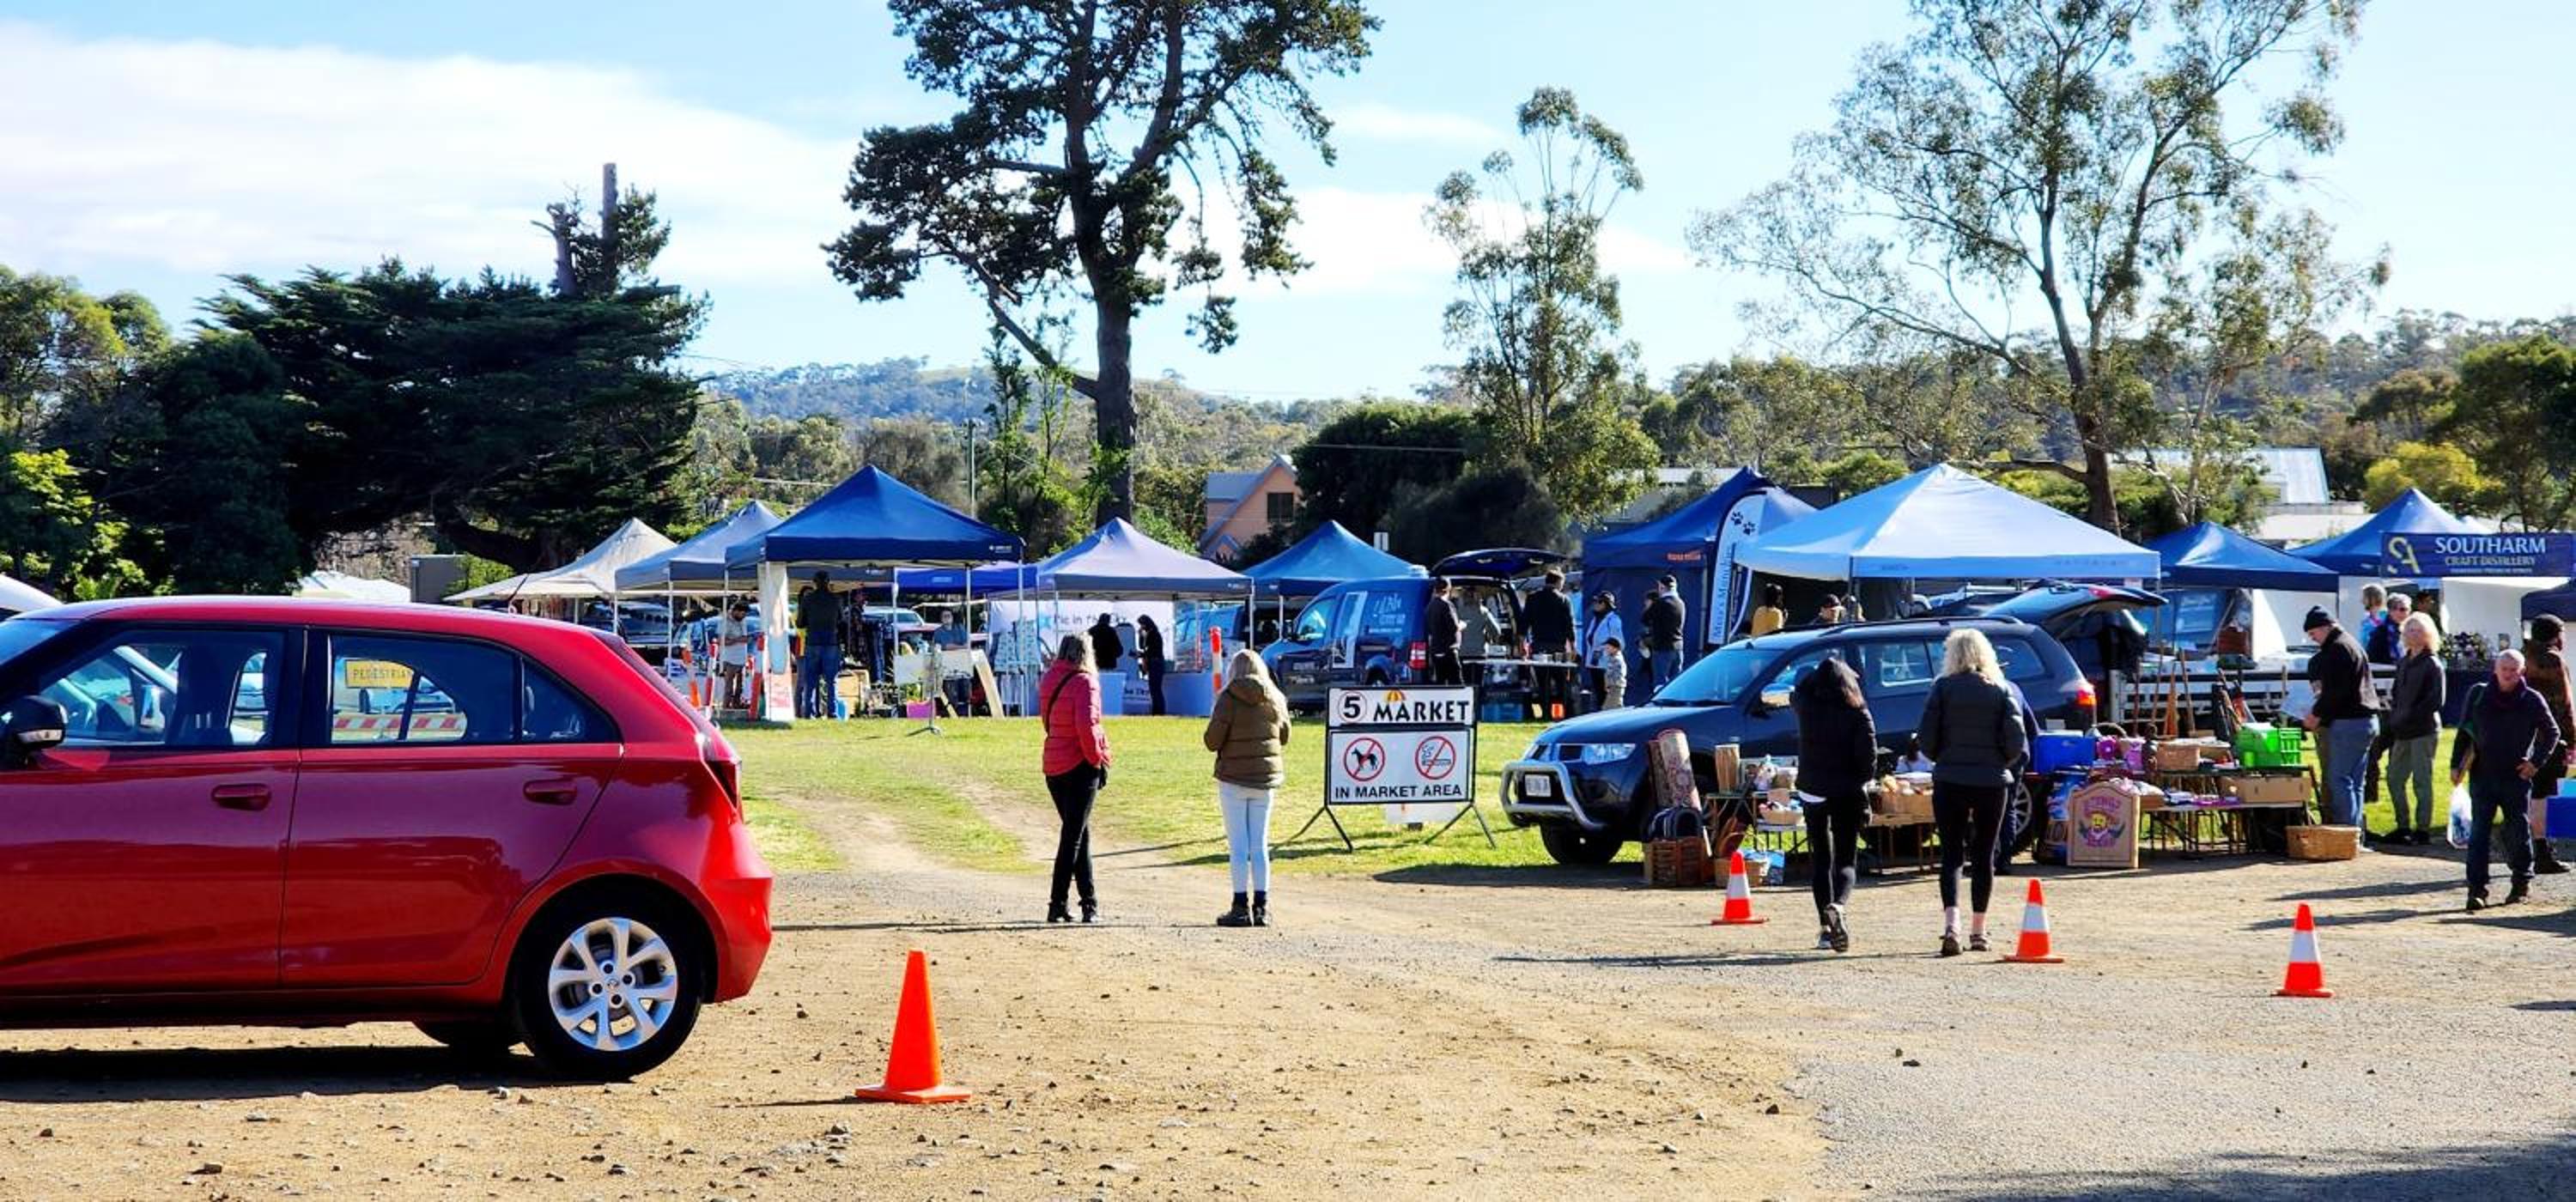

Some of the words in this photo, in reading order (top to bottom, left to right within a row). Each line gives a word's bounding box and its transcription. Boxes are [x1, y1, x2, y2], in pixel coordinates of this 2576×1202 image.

[2434, 537, 2546, 554] SOUTHARM
[2445, 556, 2478, 566] CRAFT
[2480, 556, 2536, 567] DISTILLERY
[1343, 695, 1361, 719] 5
[1373, 700, 1470, 722] MARKET
[1335, 786, 1350, 799] IN
[1355, 785, 1418, 798] MARKET
[1422, 784, 1462, 797] AREA
